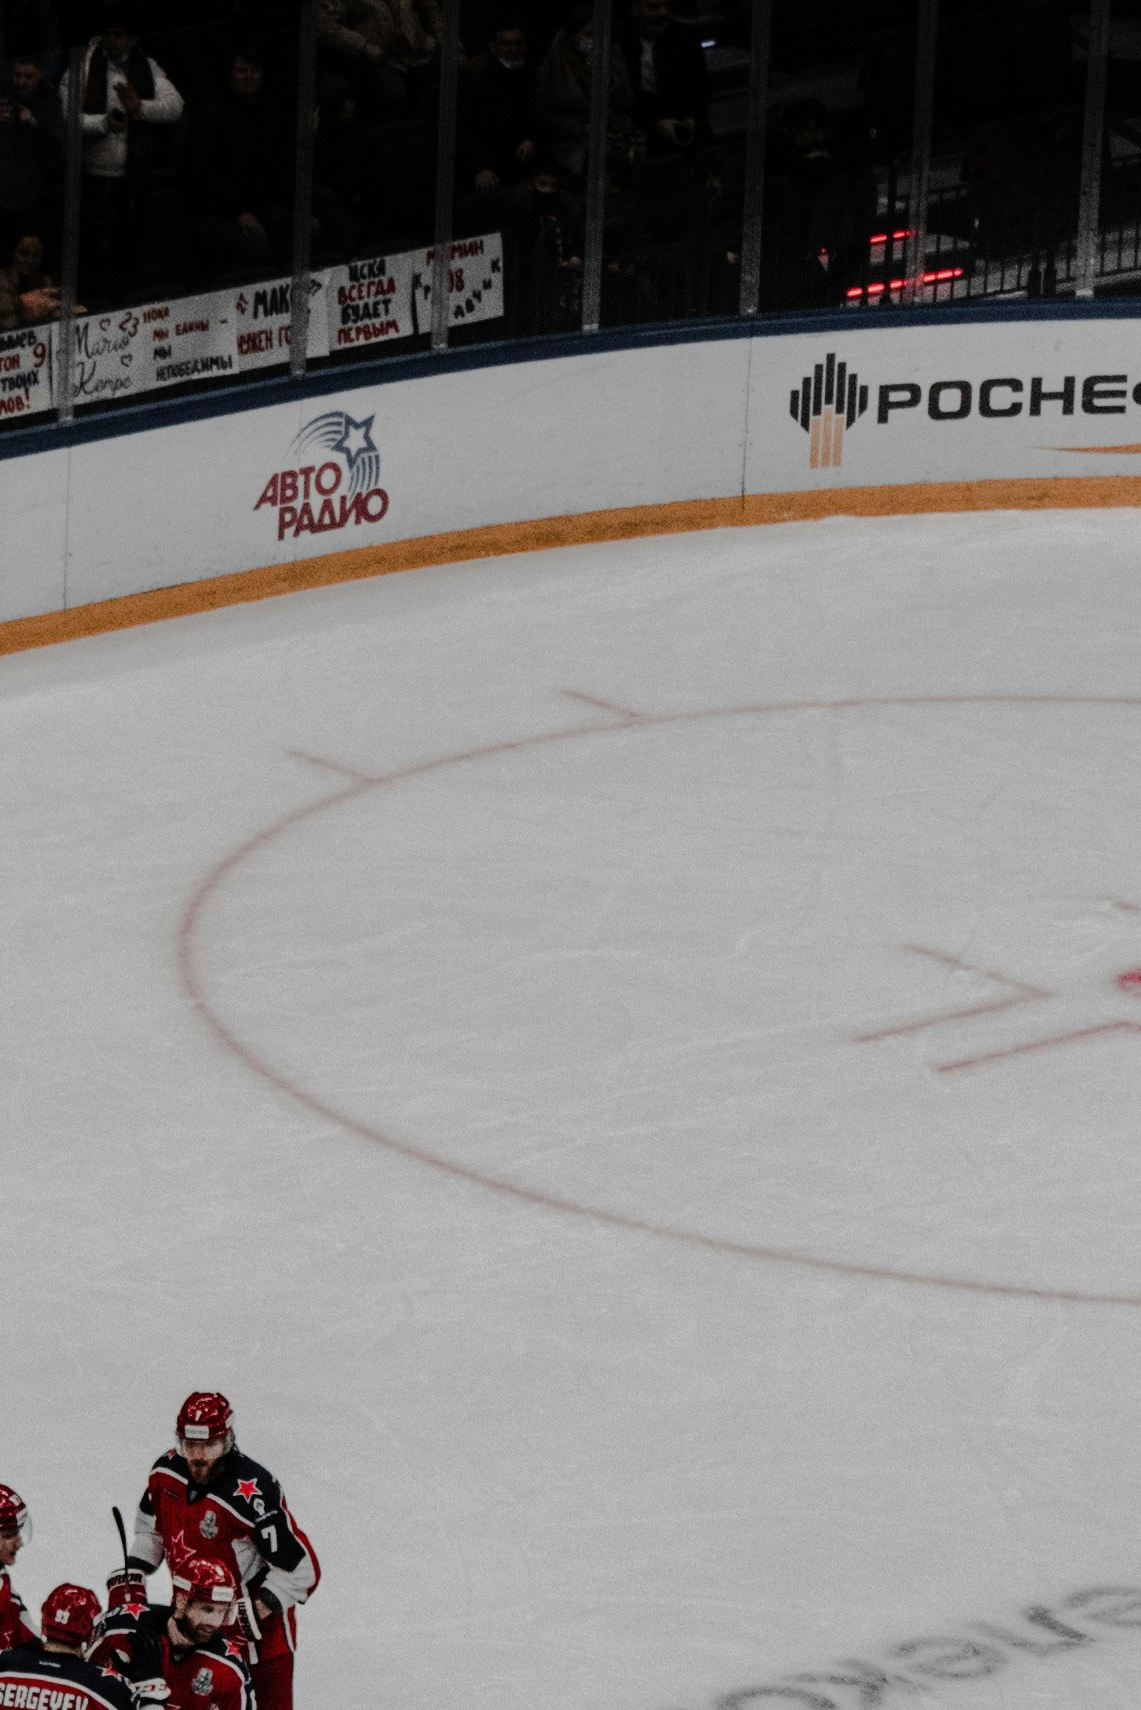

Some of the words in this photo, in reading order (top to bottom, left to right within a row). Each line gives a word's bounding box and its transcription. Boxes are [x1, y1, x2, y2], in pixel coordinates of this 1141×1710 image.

[349, 258, 387, 282] ЦСКА
[338, 277, 397, 305] ВСЕГДА
[118, 311, 140, 337] 23
[341, 298, 392, 326] БУДЕТ
[338, 319, 400, 346] ПЕРВЫМ
[33, 343, 47, 368] 9
[877, 374, 1141, 424] РОСНЕ
[253, 461, 342, 511] АВТО
[278, 488, 389, 541] РАДИО
[261, 1525, 278, 1553] 7
